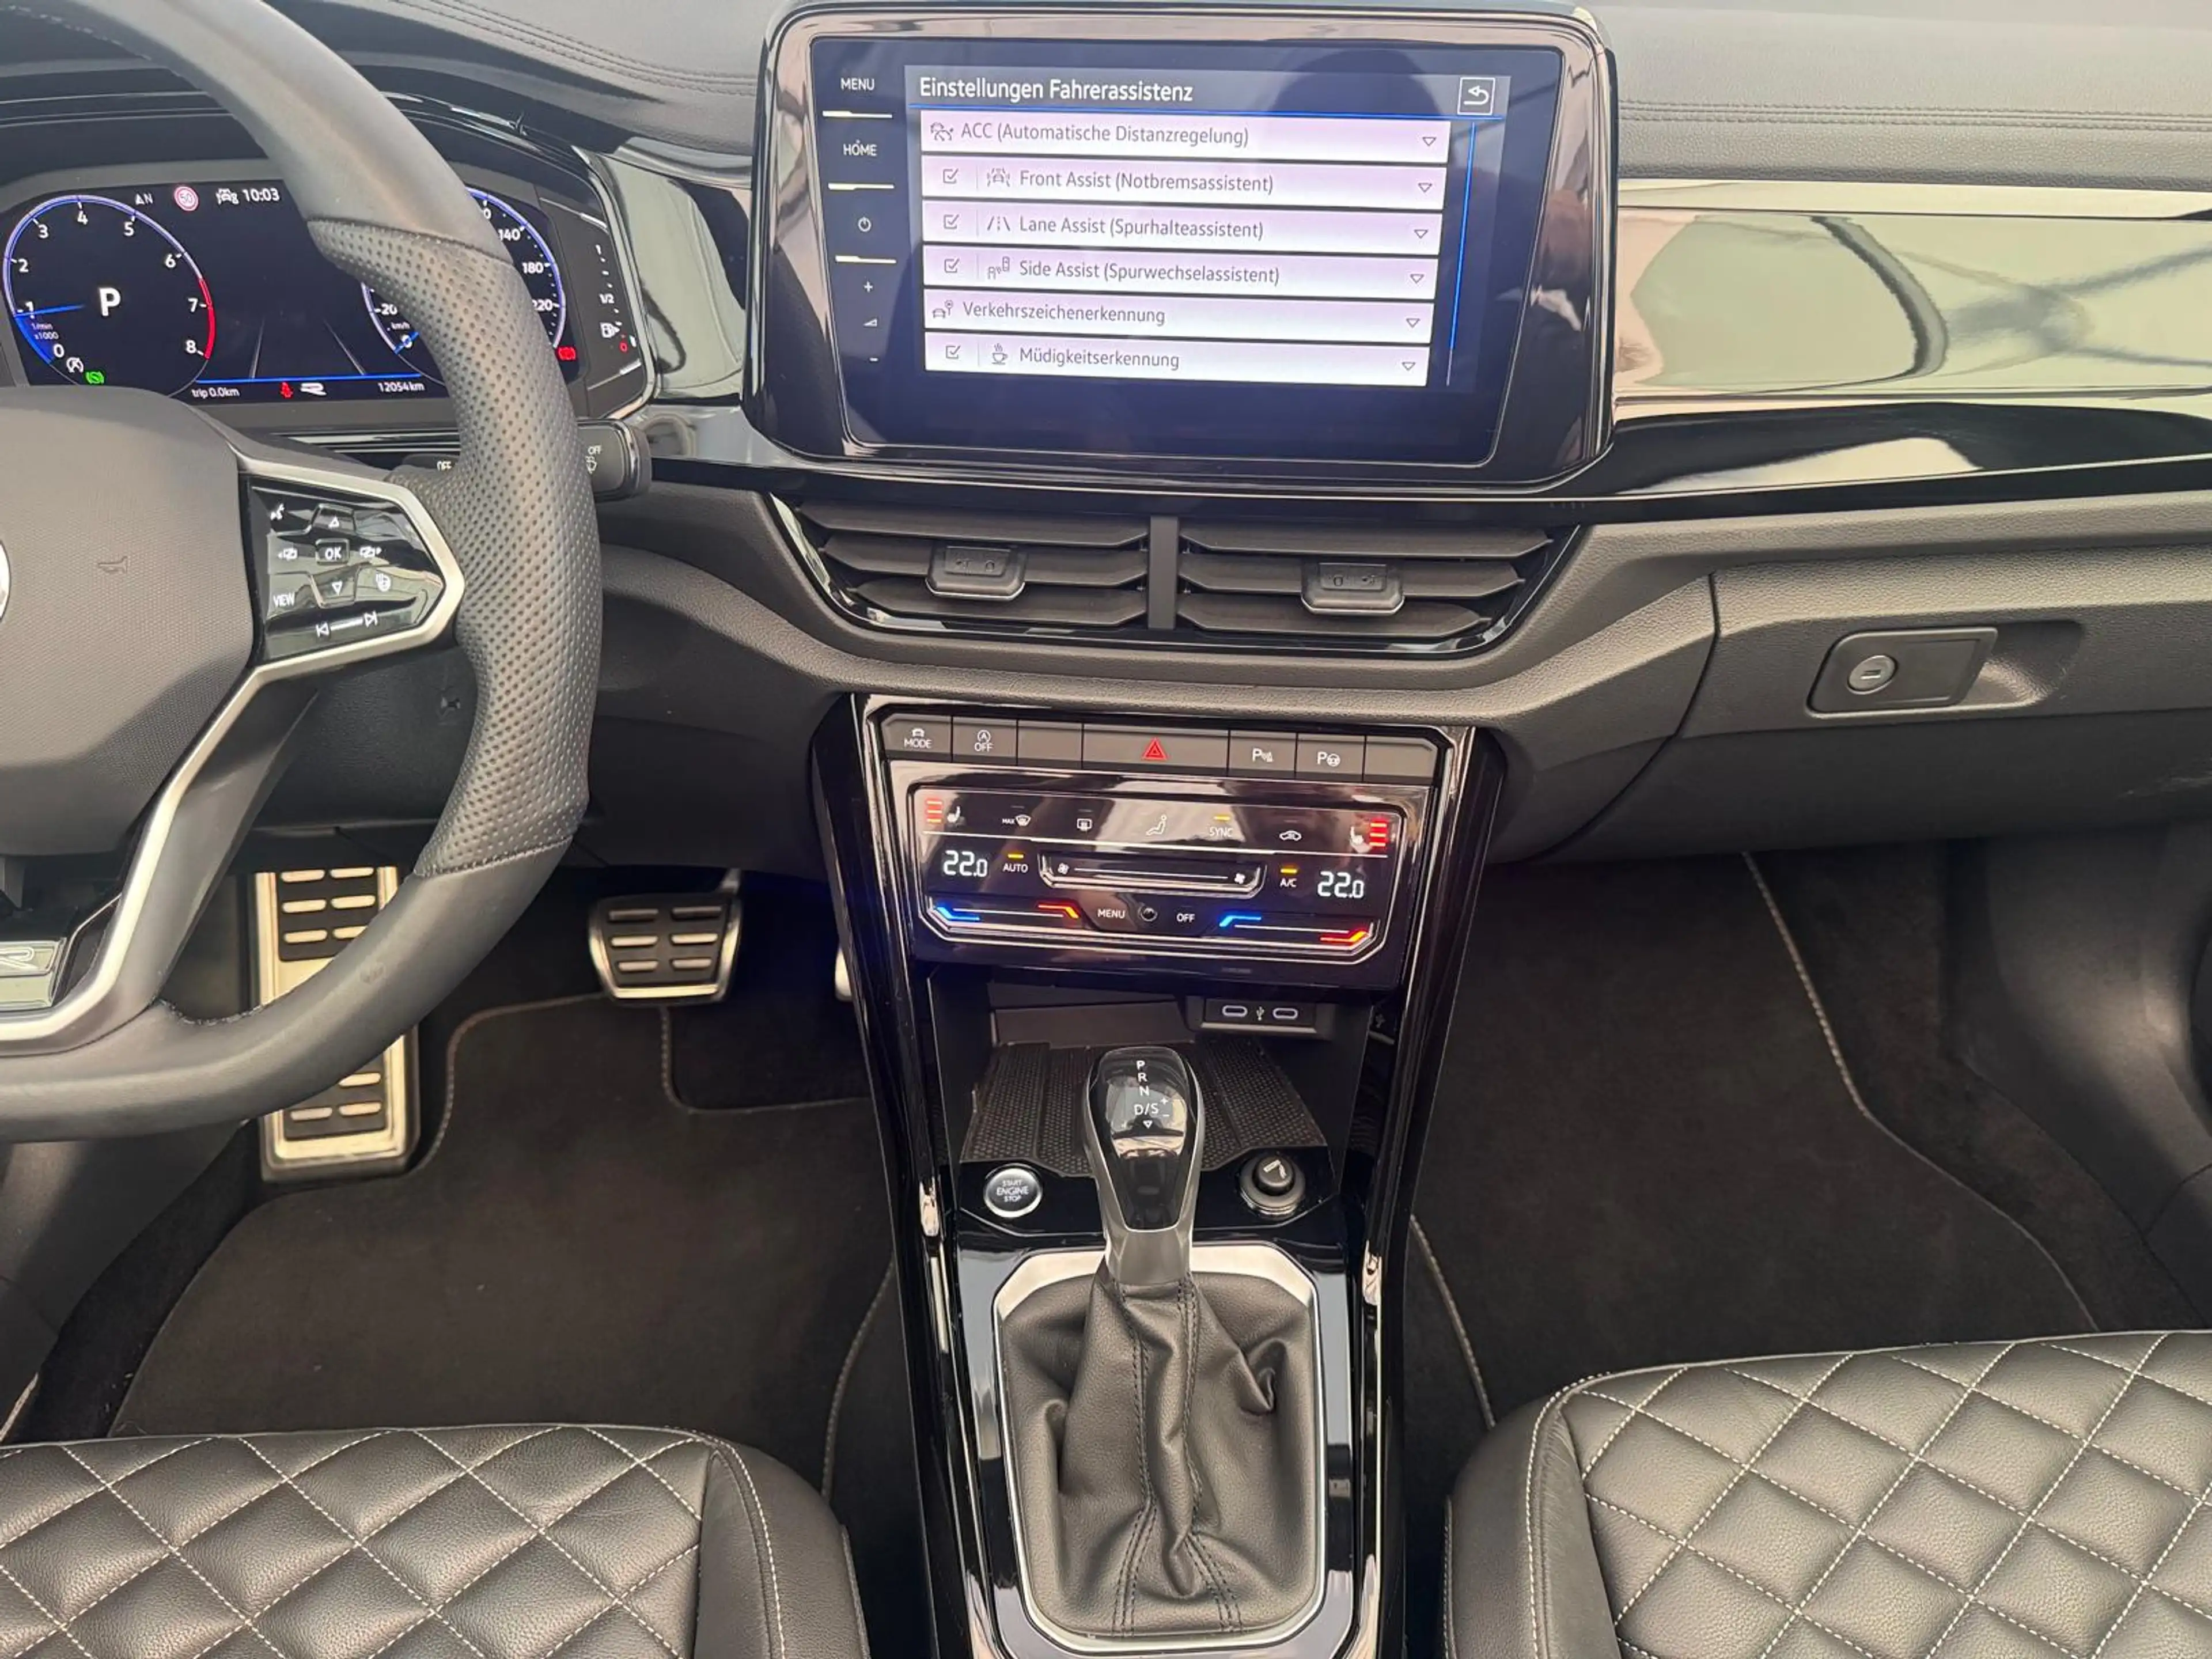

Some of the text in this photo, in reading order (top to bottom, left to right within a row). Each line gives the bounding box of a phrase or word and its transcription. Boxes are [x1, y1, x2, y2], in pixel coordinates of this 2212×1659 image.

[840, 77, 874, 91] MENU
[920, 77, 1193, 103] Einstellungen Fahrerassistenz
[961, 123, 1249, 149] ACC (Automatische Distanzregelung)
[843, 143, 877, 156] HOME
[1020, 170, 1274, 194] Front Assist (Notbremsassistent)
[243, 188, 280, 202] 10:03
[77, 211, 88, 225] 4
[38, 224, 49, 238] 3
[124, 222, 134, 236] 5
[498, 229, 521, 241] 140
[1020, 218, 1264, 241] Lane Assist (Spurhalteassistent)
[18, 259, 29, 273] 2
[165, 253, 176, 268] 6
[522, 263, 544, 274] 180
[1019, 262, 1280, 286] Side Assist (Spurwechselassistent)
[98, 287, 121, 316] P
[188, 298, 198, 312] 7
[25, 301, 35, 319] 1
[381, 303, 397, 315] 20
[963, 302, 1165, 326] Verkehrszeichenerkennung
[53, 343, 65, 358] 0
[186, 339, 196, 354] 8
[1020, 347, 1179, 370] Müdigkeitserkennung
[191, 388, 207, 399] trip
[325, 546, 342, 560] OK
[273, 592, 296, 607] VIEW
[904, 738, 932, 749] MODE
[974, 742, 994, 752] OFF
[1210, 827, 1233, 838] SYNC
[943, 850, 988, 877] 22.0
[1003, 863, 1028, 873] AUTO
[1280, 877, 1297, 888] A/C
[1317, 871, 1364, 899] 22.0
[1098, 908, 1126, 919] MENU
[1177, 912, 1195, 922] OFF
[1136, 1060, 1145, 1070] P
[1138, 1073, 1147, 1082] R
[1139, 1085, 1150, 1096] N
[1134, 1103, 1159, 1115] D/S
[996, 1185, 1029, 1196] ENGINE
